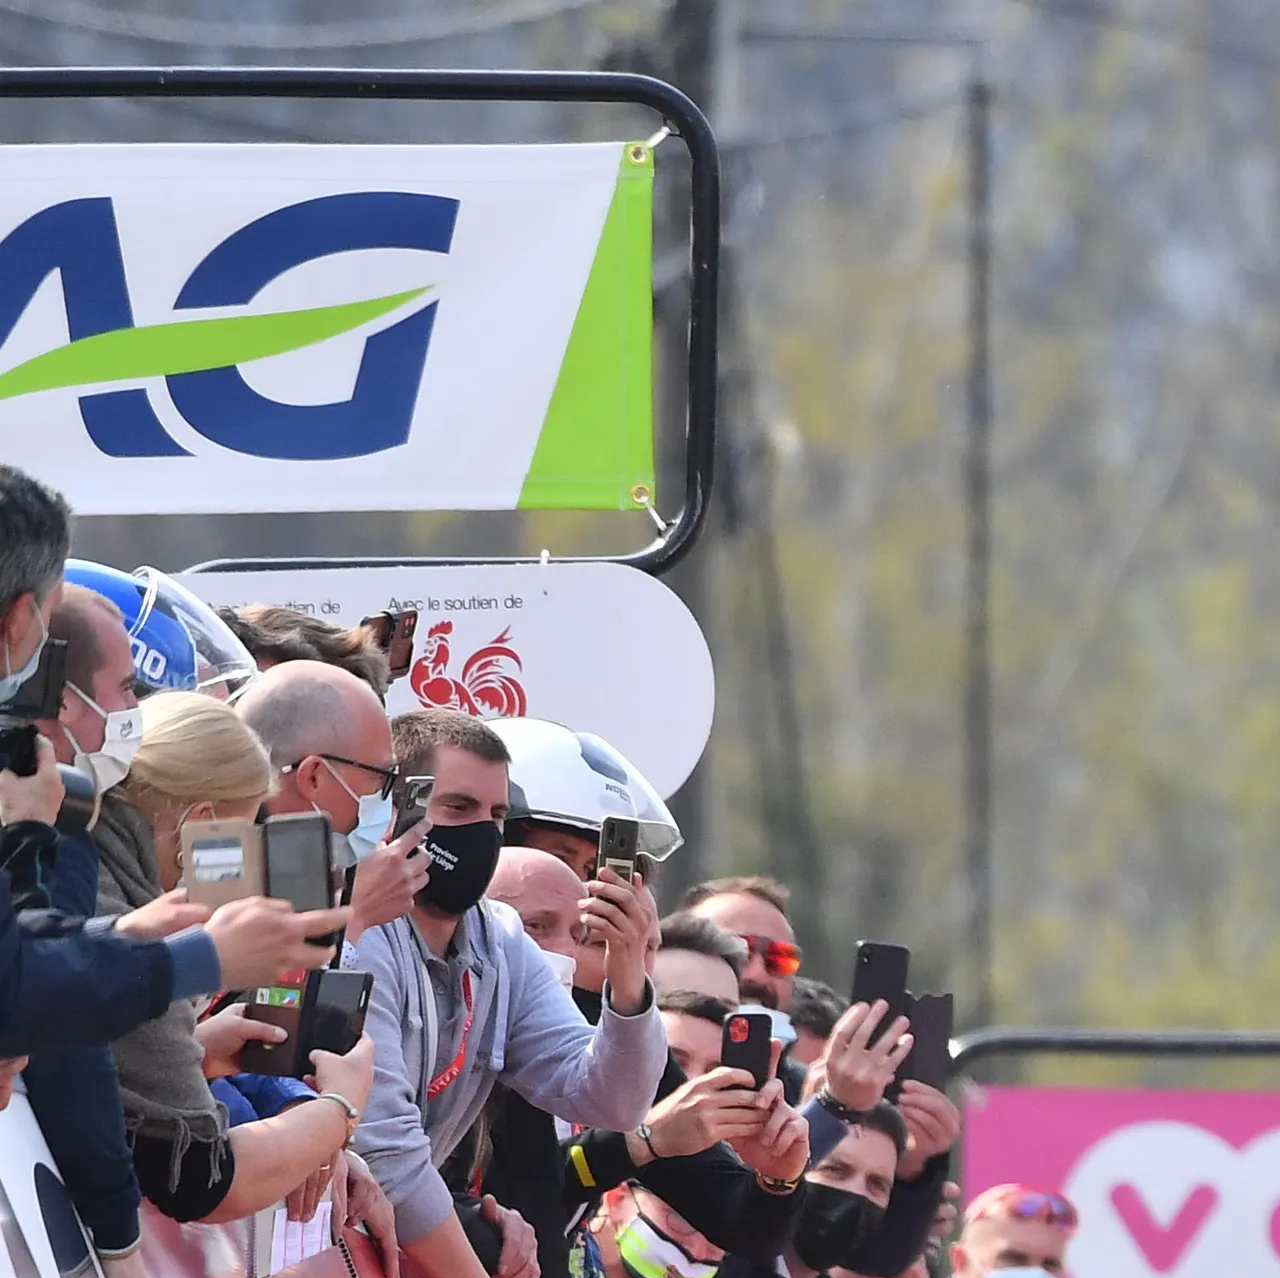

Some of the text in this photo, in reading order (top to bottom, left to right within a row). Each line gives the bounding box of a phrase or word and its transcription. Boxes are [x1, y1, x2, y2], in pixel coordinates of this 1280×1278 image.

[427, 596, 441, 611] le
[443, 595, 499, 611] soutien
[503, 594, 523, 609] de
